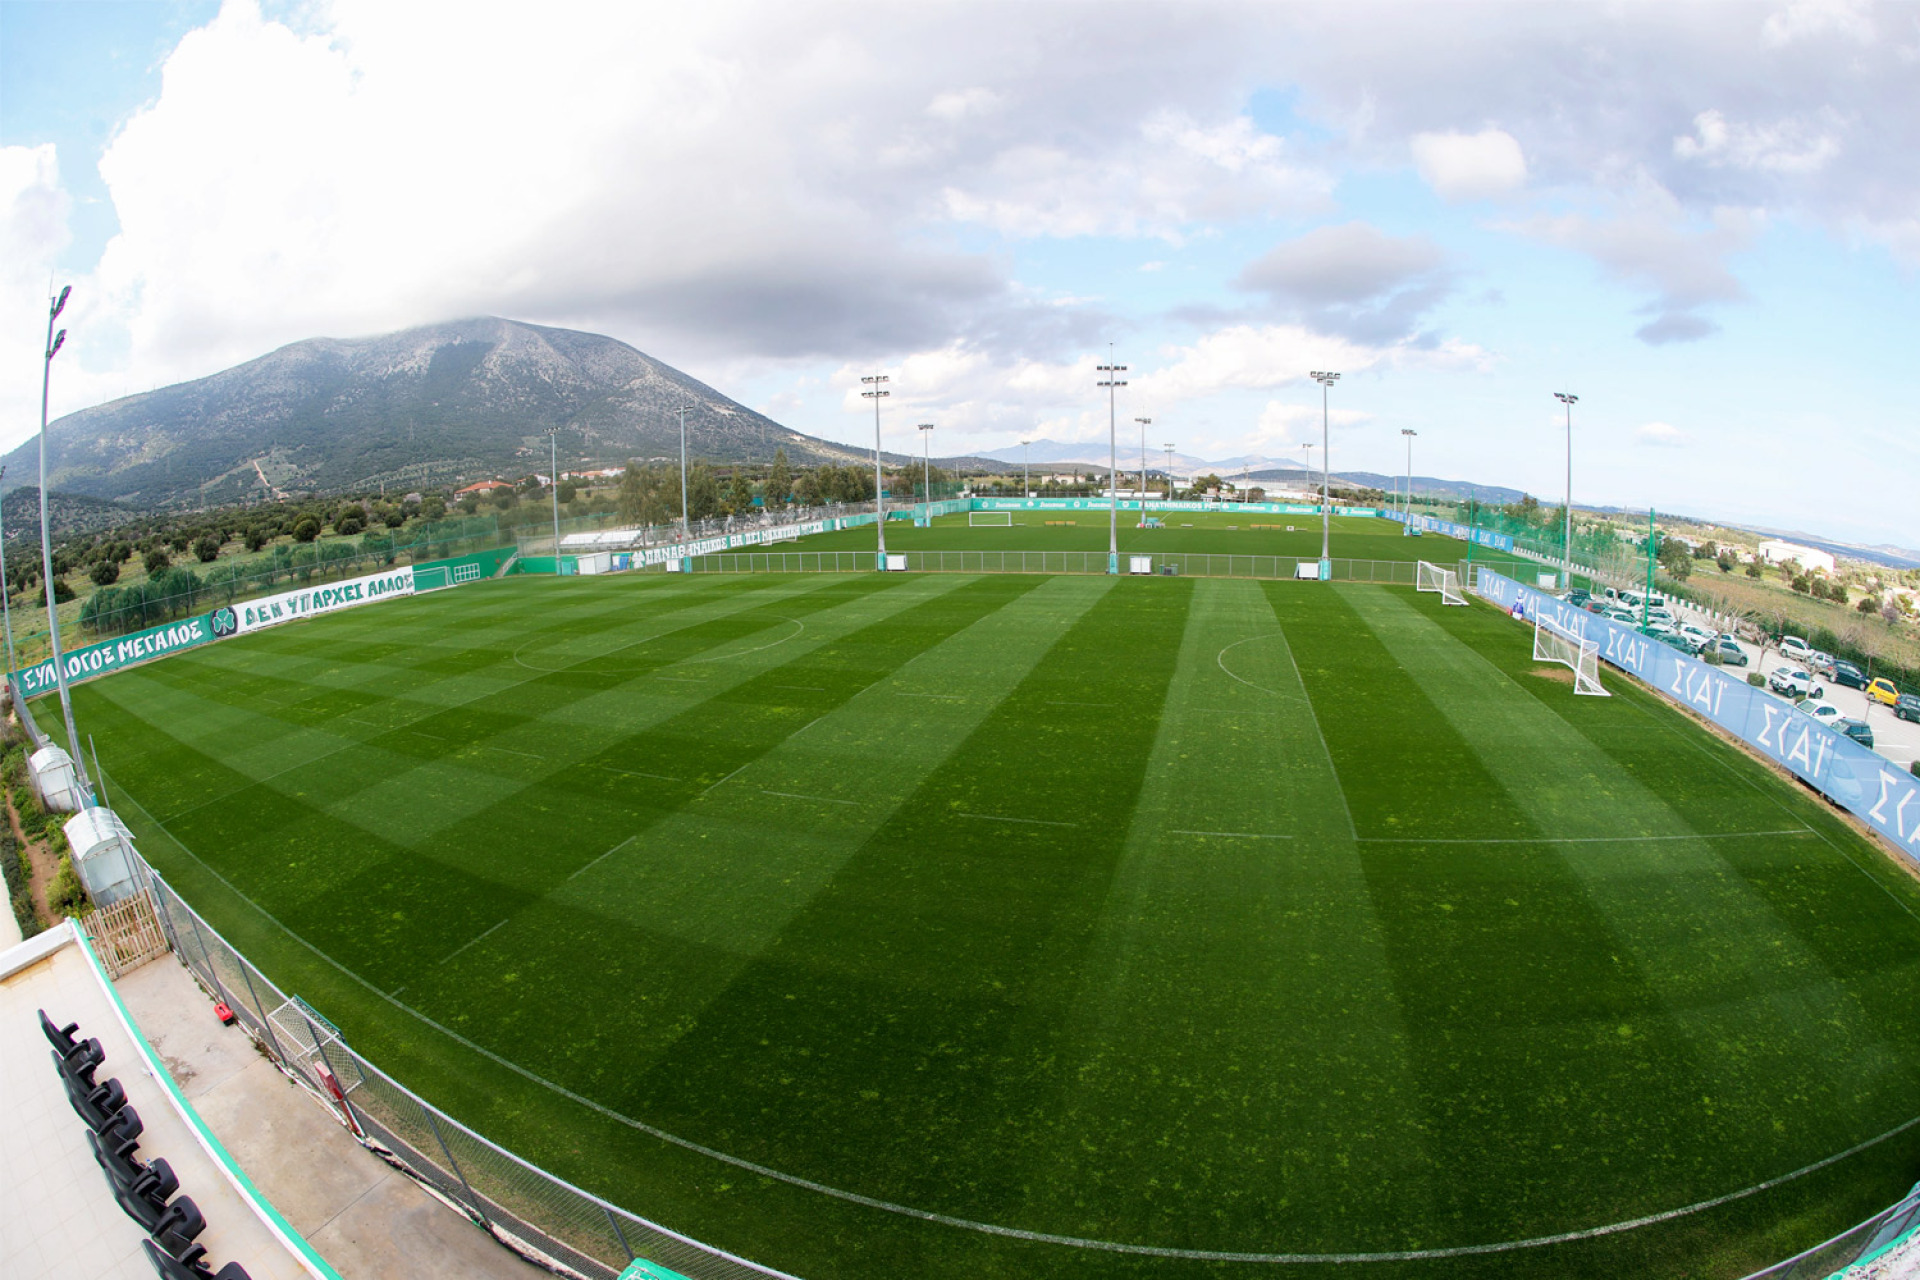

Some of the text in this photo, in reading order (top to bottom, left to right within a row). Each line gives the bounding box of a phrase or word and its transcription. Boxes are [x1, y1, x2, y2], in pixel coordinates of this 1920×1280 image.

[245, 573, 414, 626] ΔΕΝ ΥΠΑΡΧΕΙ ΑΛΛΟΣ
[118, 620, 203, 663] ΜΕΓΑΛΟΣ
